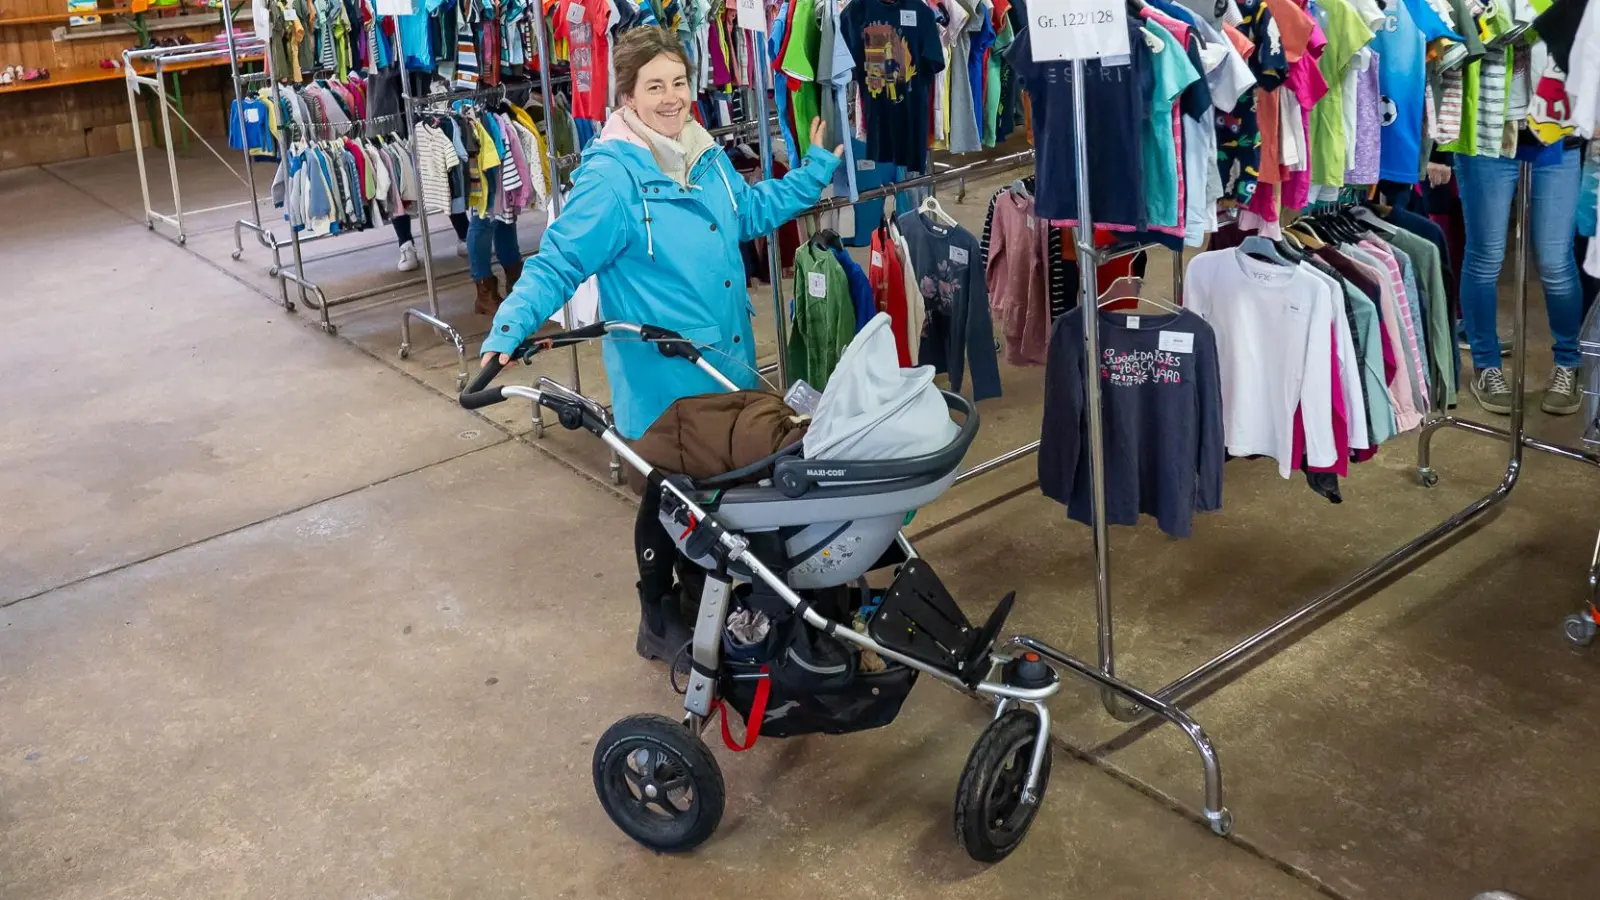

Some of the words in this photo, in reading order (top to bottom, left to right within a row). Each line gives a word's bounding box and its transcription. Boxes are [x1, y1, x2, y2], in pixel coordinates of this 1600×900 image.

[1037, 15, 1057, 28] Gr.
[1062, 9, 1114, 27] 122/128
[1048, 66, 1132, 84] ESPRI
[1125, 360, 1154, 374] BACK
